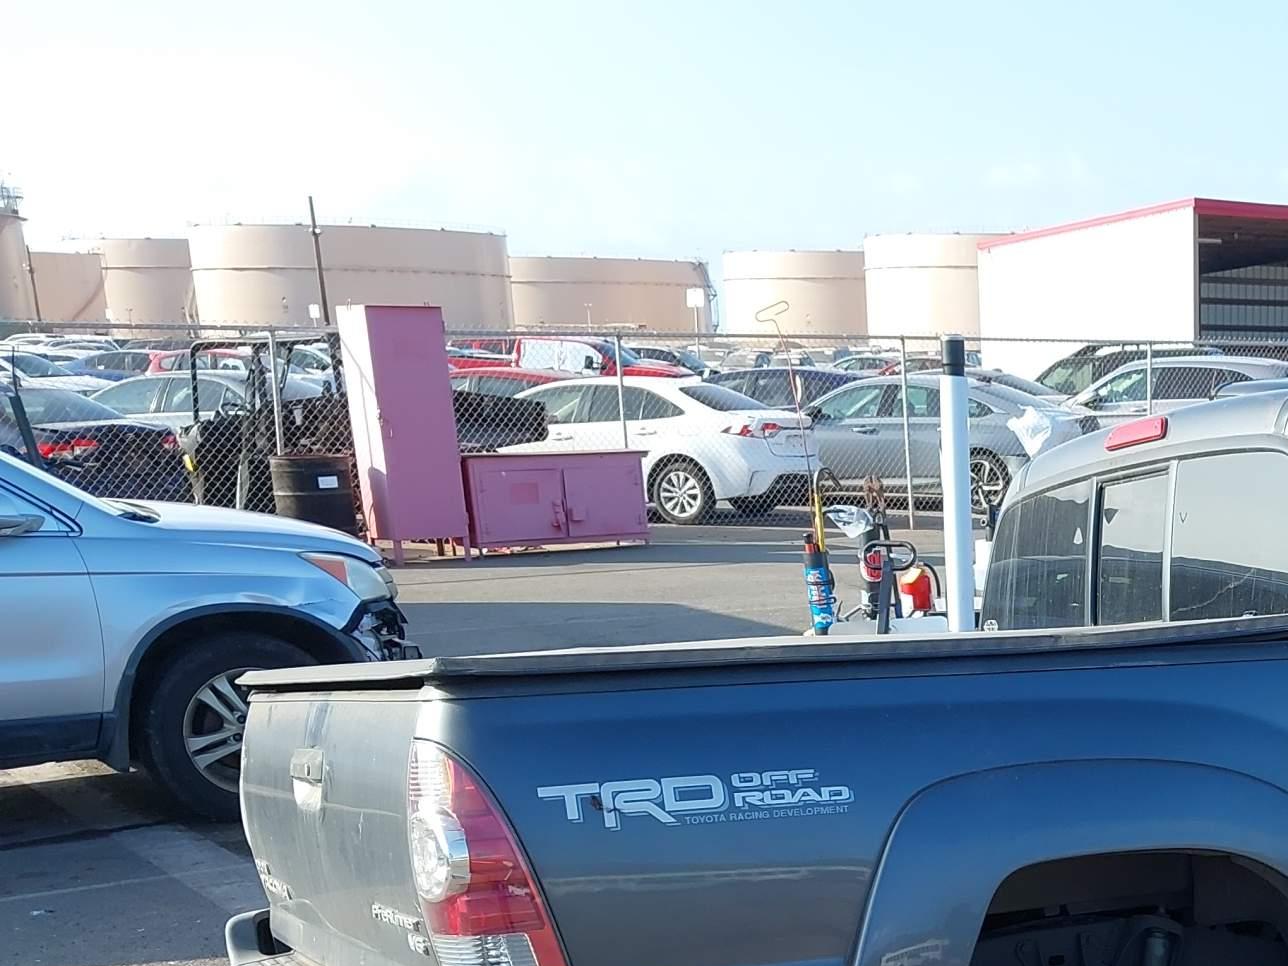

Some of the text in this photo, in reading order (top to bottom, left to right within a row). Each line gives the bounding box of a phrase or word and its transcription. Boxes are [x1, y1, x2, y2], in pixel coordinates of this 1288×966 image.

[730, 768, 820, 789] OFF
[537, 774, 729, 832] TRD
[733, 785, 854, 809] ROAD
[684, 805, 849, 825] TOYOTA RACING DEVELOPMENT
